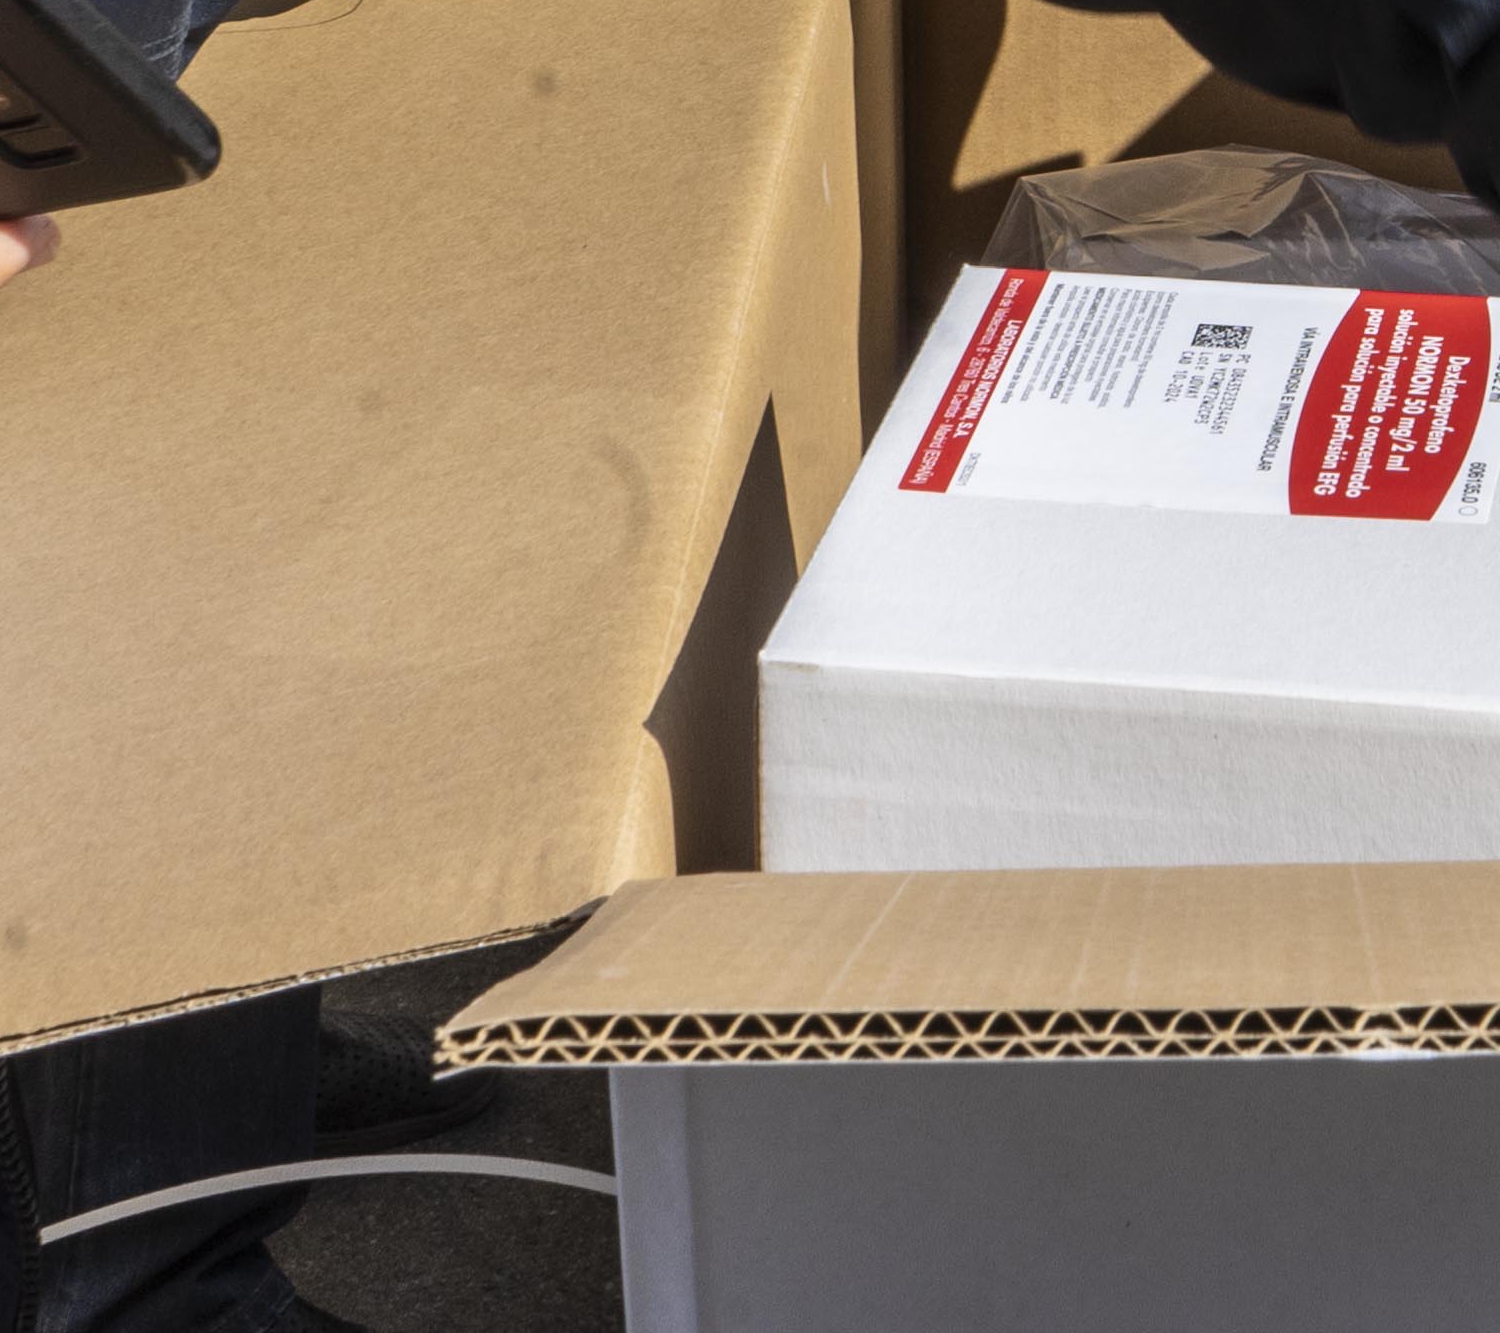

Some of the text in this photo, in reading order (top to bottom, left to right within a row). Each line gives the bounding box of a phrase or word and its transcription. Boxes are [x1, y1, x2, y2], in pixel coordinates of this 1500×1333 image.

[980, 319, 1023, 379] LABORATORIOS
[1193, 352, 1213, 370] Lote
[1286, 340, 1314, 395] INTRAVENOSA
[957, 380, 992, 421] NORMON,
[1161, 370, 1190, 404] 10-2024
[1314, 307, 1385, 496] para solución para perfusión EFG
[1345, 309, 1418, 499] solución inyectable o concentrado
[1385, 335, 1444, 471] NORMON 50 mg/2 ml
[1424, 355, 1470, 454] Dexketoprofeno
[1256, 403, 1293, 471] INTRAMUSCULAR
